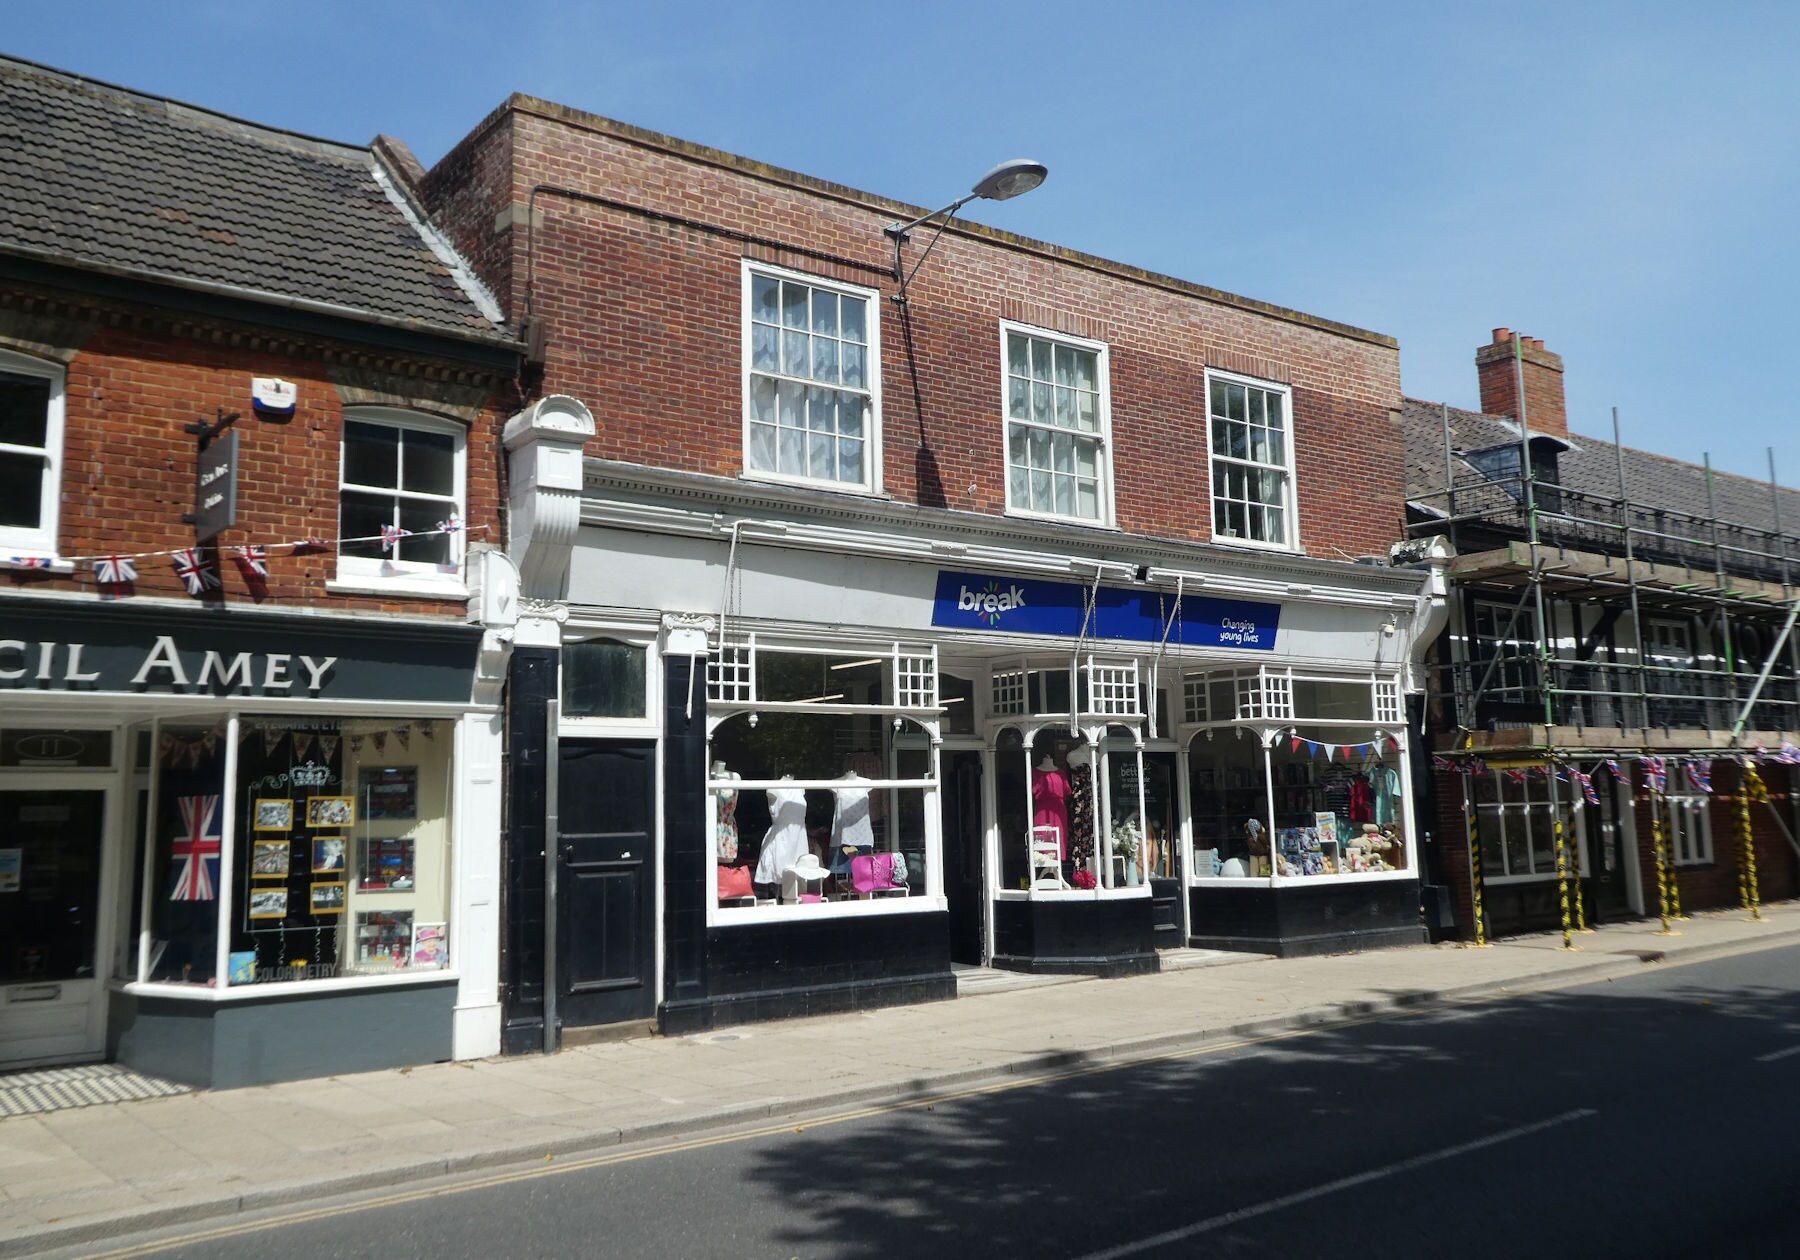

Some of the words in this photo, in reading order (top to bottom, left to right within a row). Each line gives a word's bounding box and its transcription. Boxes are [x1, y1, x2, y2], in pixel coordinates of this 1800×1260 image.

[958, 584, 1026, 613] break
[1221, 617, 1255, 633] Changing
[1219, 632, 1242, 645] young
[1243, 631, 1259, 643] lives
[130, 635, 338, 690] AMEY
